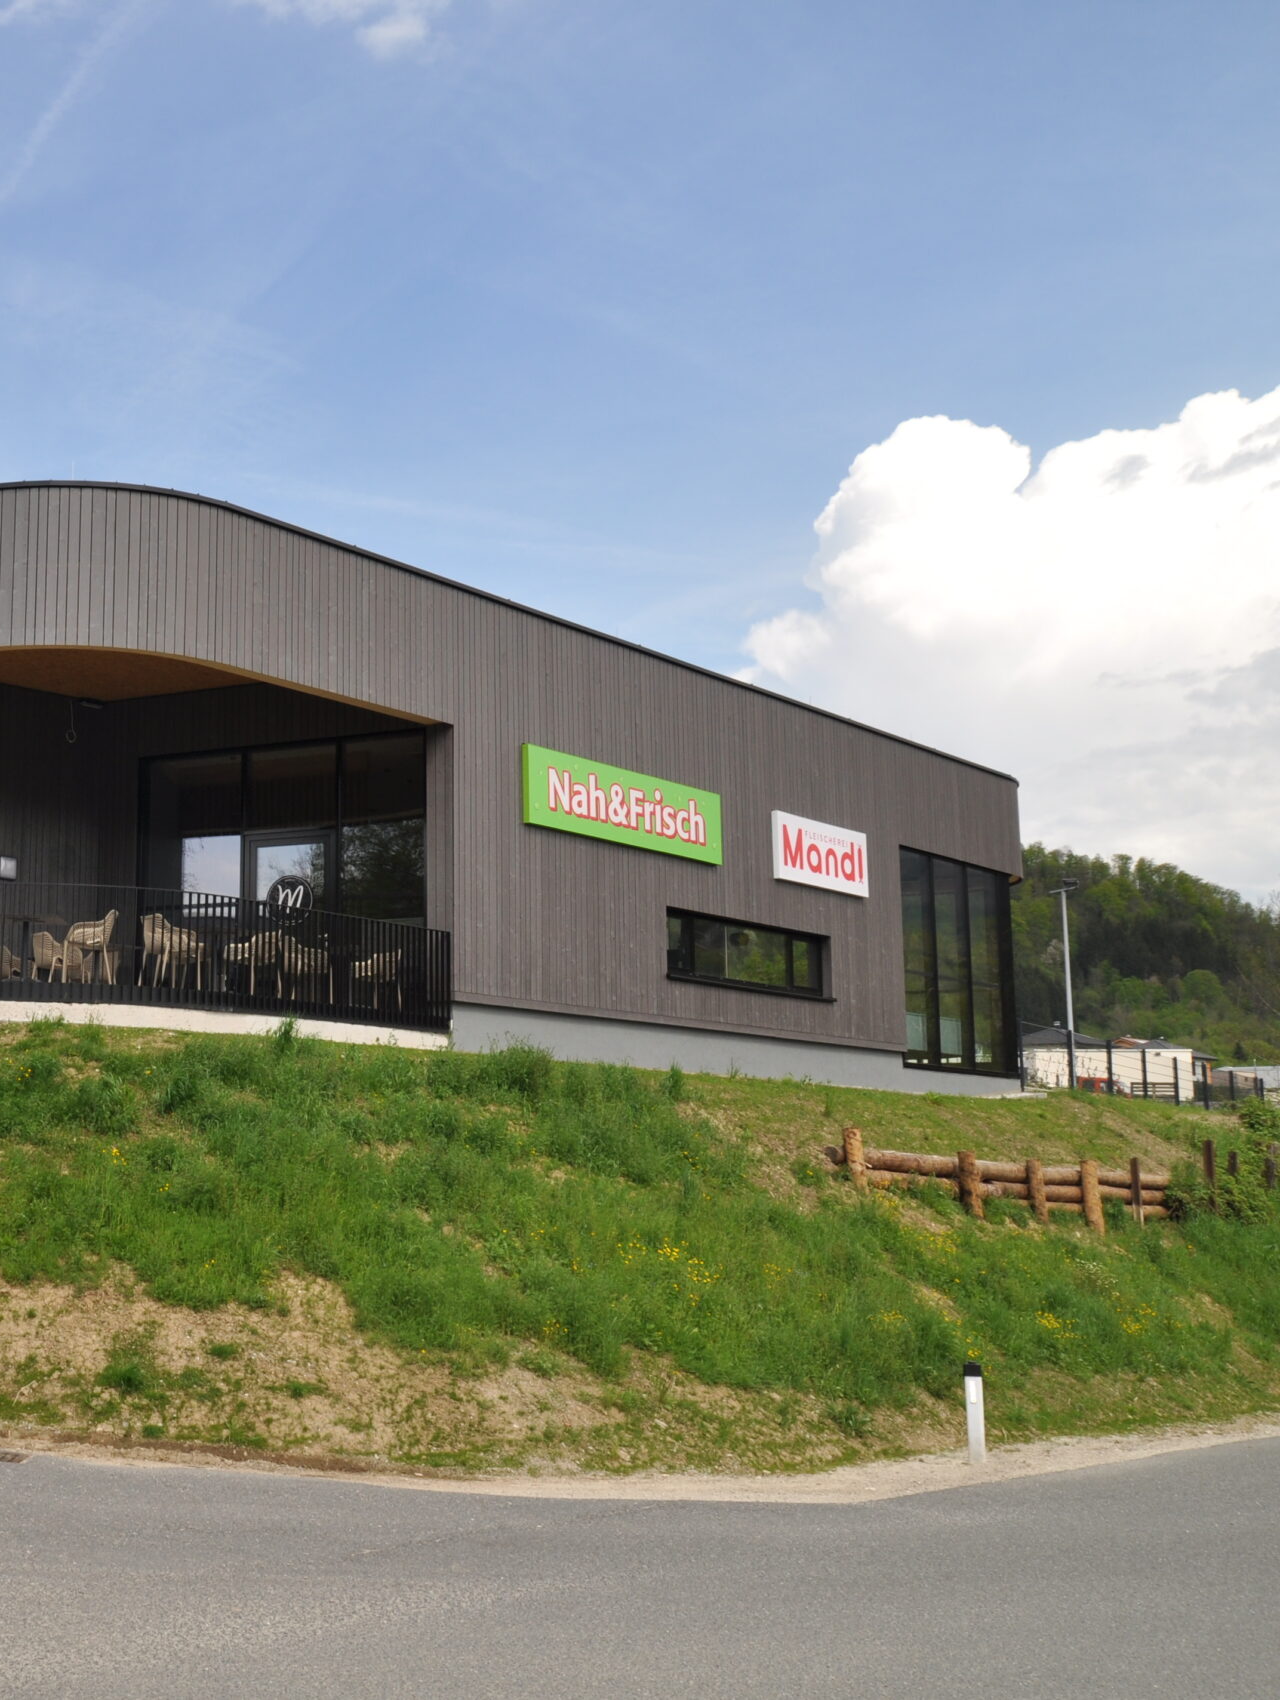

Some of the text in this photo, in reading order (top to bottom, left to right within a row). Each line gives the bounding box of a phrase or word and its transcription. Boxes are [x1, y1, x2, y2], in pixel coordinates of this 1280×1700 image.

[547, 766, 707, 847] Nah&Frisch
[782, 823, 864, 884] Mandl
[804, 830, 849, 848] FLEISCHEREI
